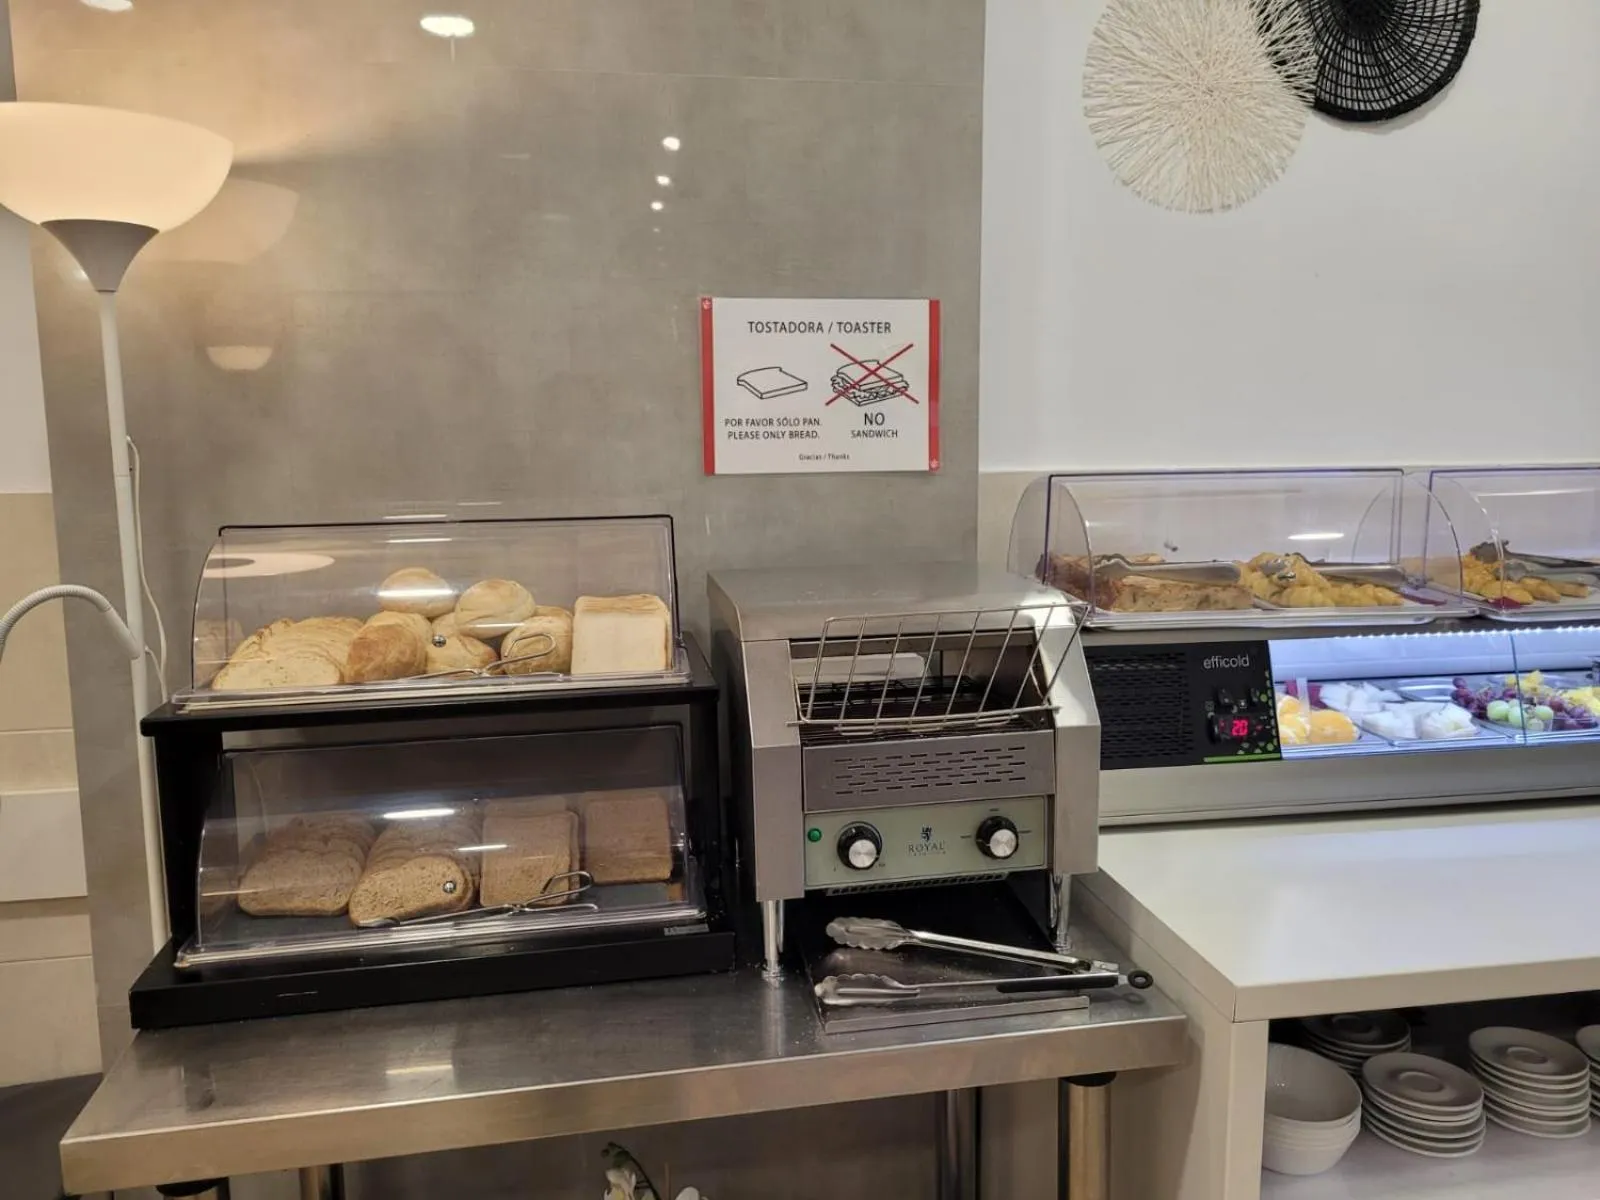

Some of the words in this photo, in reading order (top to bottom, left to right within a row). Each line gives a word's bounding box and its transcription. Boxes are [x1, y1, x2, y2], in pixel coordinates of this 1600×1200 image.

[748, 321, 824, 334] TOSTADORA
[828, 321, 833, 334] /
[837, 321, 892, 334] TOASTER
[725, 418, 743, 427] POR
[745, 418, 774, 427] FAVOR
[777, 416, 800, 427] SÓLO
[864, 412, 885, 426] NO
[728, 431, 760, 440] PLEASE
[762, 430, 786, 439] ONLY
[788, 430, 819, 439] BREAD.
[851, 429, 898, 438] SANDWICH
[1203, 654, 1250, 669] efficold
[908, 842, 944, 852] ROYAL
